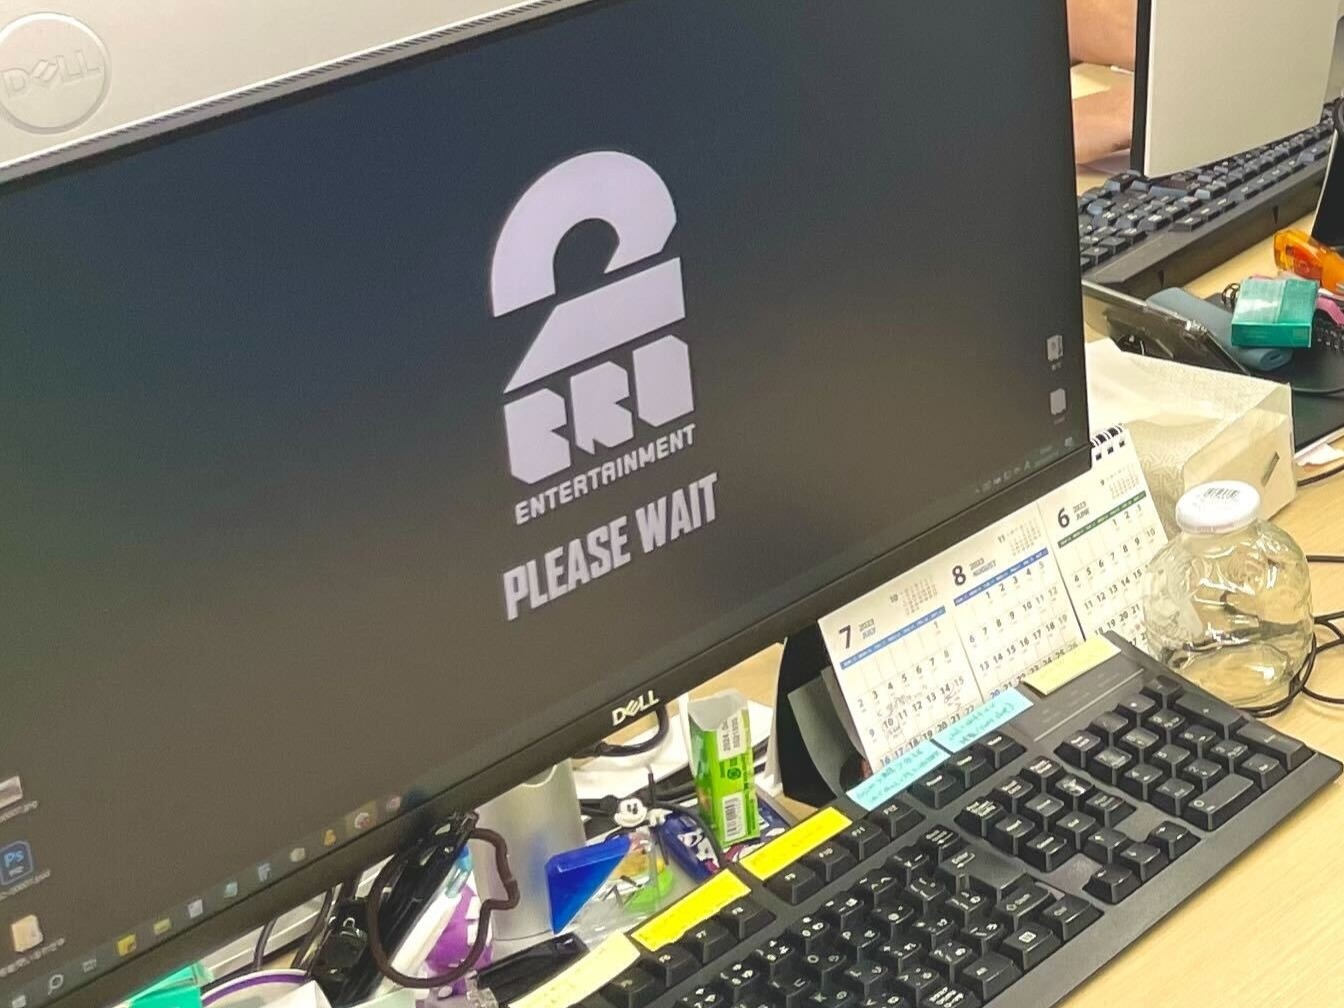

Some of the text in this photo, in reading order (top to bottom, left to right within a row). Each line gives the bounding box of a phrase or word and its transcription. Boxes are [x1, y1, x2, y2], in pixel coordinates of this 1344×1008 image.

[515, 424, 696, 525] ENTERTAINMENT
[1058, 507, 1070, 528] 6
[502, 473, 718, 621] PLEASE WAIT
[952, 565, 966, 586] 8
[838, 625, 851, 649] 7
[612, 690, 660, 727] DELL
